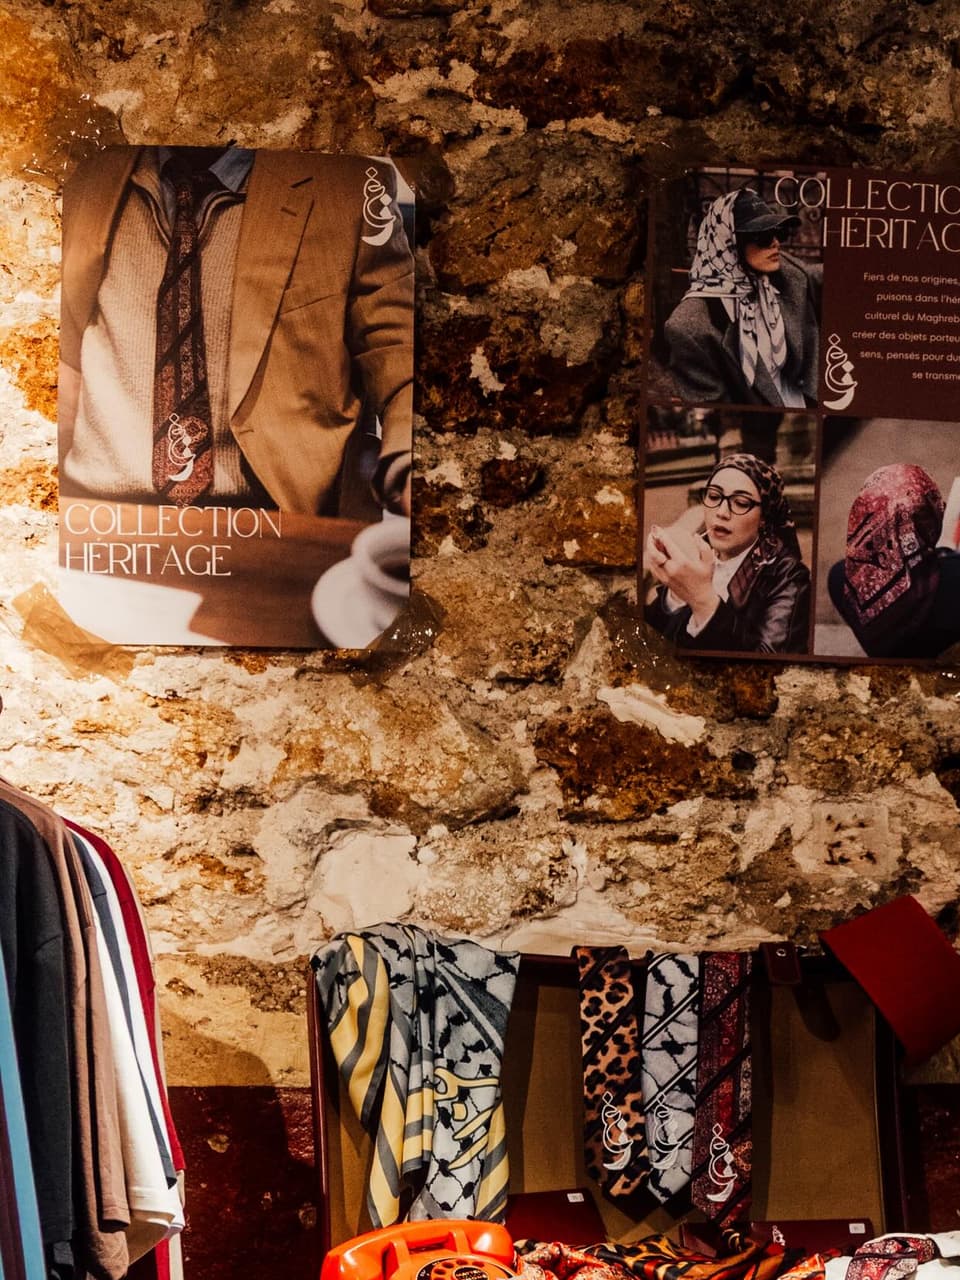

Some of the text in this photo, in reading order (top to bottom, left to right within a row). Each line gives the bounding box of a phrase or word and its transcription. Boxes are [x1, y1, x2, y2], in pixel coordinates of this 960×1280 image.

[863, 272, 885, 282] Fiers
[887, 273, 899, 282] de
[902, 274, 919, 283] nos
[921, 273, 960, 286] origines,
[876, 292, 913, 304] puisons
[915, 293, 938, 303] dans
[864, 311, 900, 321] culturel
[902, 313, 914, 322] du
[917, 313, 960, 324] Maghreb
[852, 330, 877, 340] créer
[878, 331, 896, 340] des
[899, 332, 927, 344] objets
[860, 351, 884, 360] sens,
[886, 350, 920, 361] pensés
[922, 353, 944, 362] pour
[912, 371, 923, 380] se
[64, 503, 282, 538] COLLECTION
[65, 537, 232, 576] HÉRITAGE
